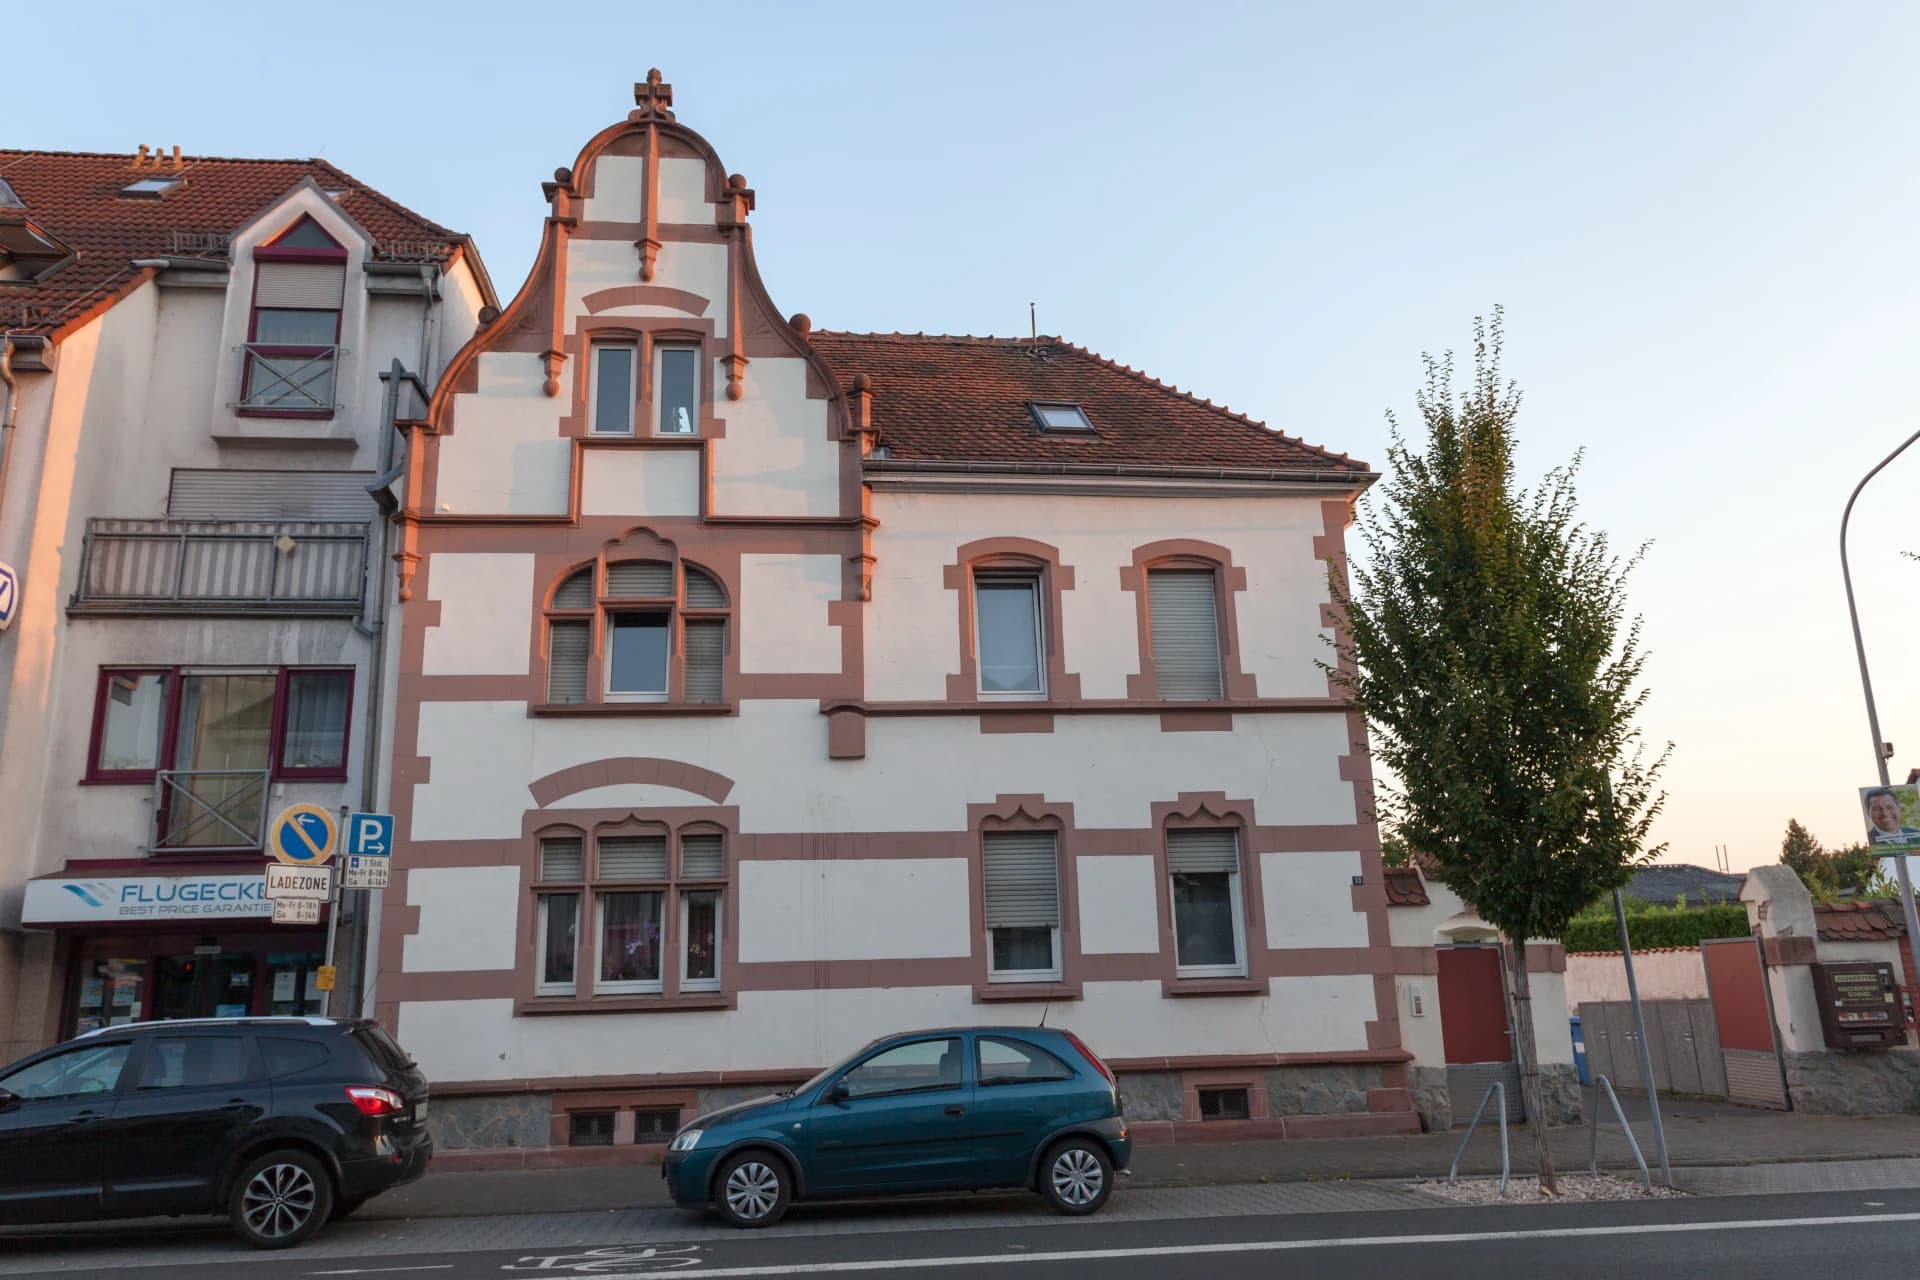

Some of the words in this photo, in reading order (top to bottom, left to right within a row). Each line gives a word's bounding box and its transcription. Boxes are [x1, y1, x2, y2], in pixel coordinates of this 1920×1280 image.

[358, 819, 383, 852] P
[270, 876, 328, 891] LADEZONE
[347, 878, 358, 886] Sa
[119, 905, 154, 915] BEST
[158, 904, 199, 914] PRICE
[202, 903, 271, 913] GARANTIE
[276, 901, 296, 909] Mo-Fr
[276, 911, 287, 919] Sa
